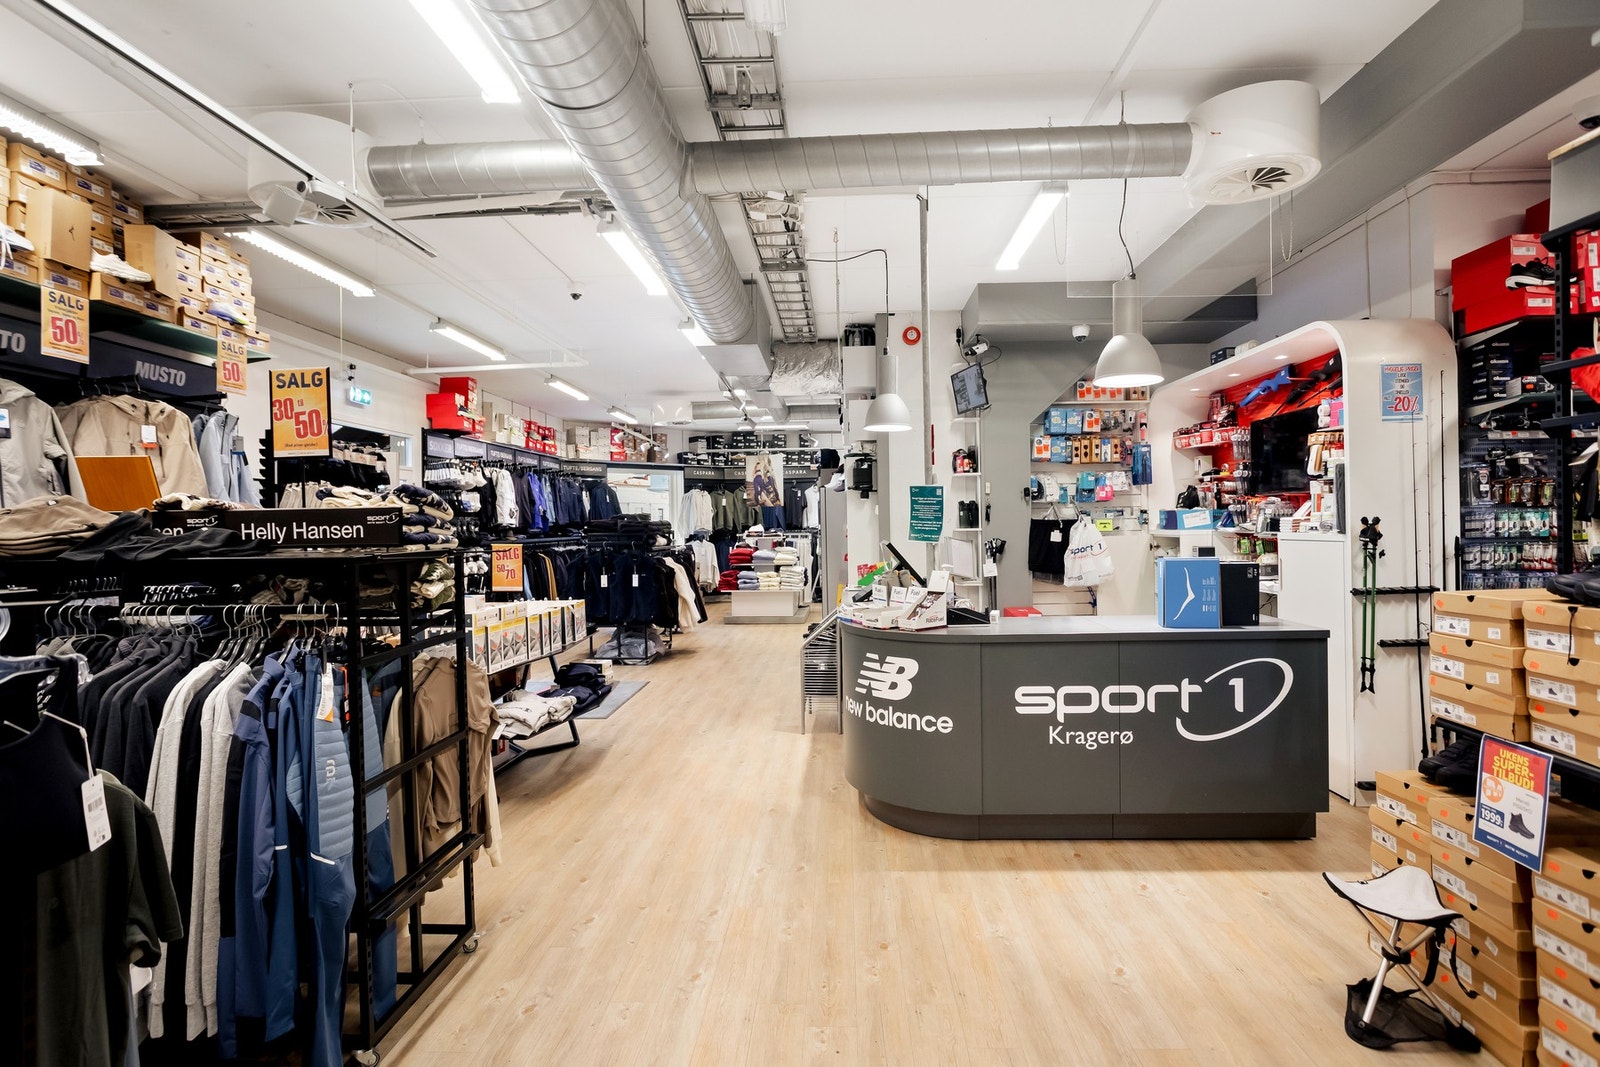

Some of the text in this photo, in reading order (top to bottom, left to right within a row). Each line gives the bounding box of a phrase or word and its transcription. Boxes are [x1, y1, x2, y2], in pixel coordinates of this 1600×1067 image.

[48, 291, 84, 311] SALG
[51, 316, 78, 345] 50
[221, 341, 244, 355] SALG
[135, 360, 186, 387] MUSTO
[222, 361, 241, 382] 50
[276, 371, 324, 389] SALG
[272, 398, 294, 421] 30
[1387, 396, 1419, 412] -20%
[241, 521, 364, 544] Helly Hansen
[495, 547, 519, 561] SALG
[1014, 677, 1244, 723] sport 1
[845, 695, 954, 734] new balance
[1048, 725, 1134, 750] Kragerø
[1493, 755, 1534, 778] SUPER-
[1500, 748, 1529, 767] UKENS
[1492, 764, 1535, 792] TILBUD!
